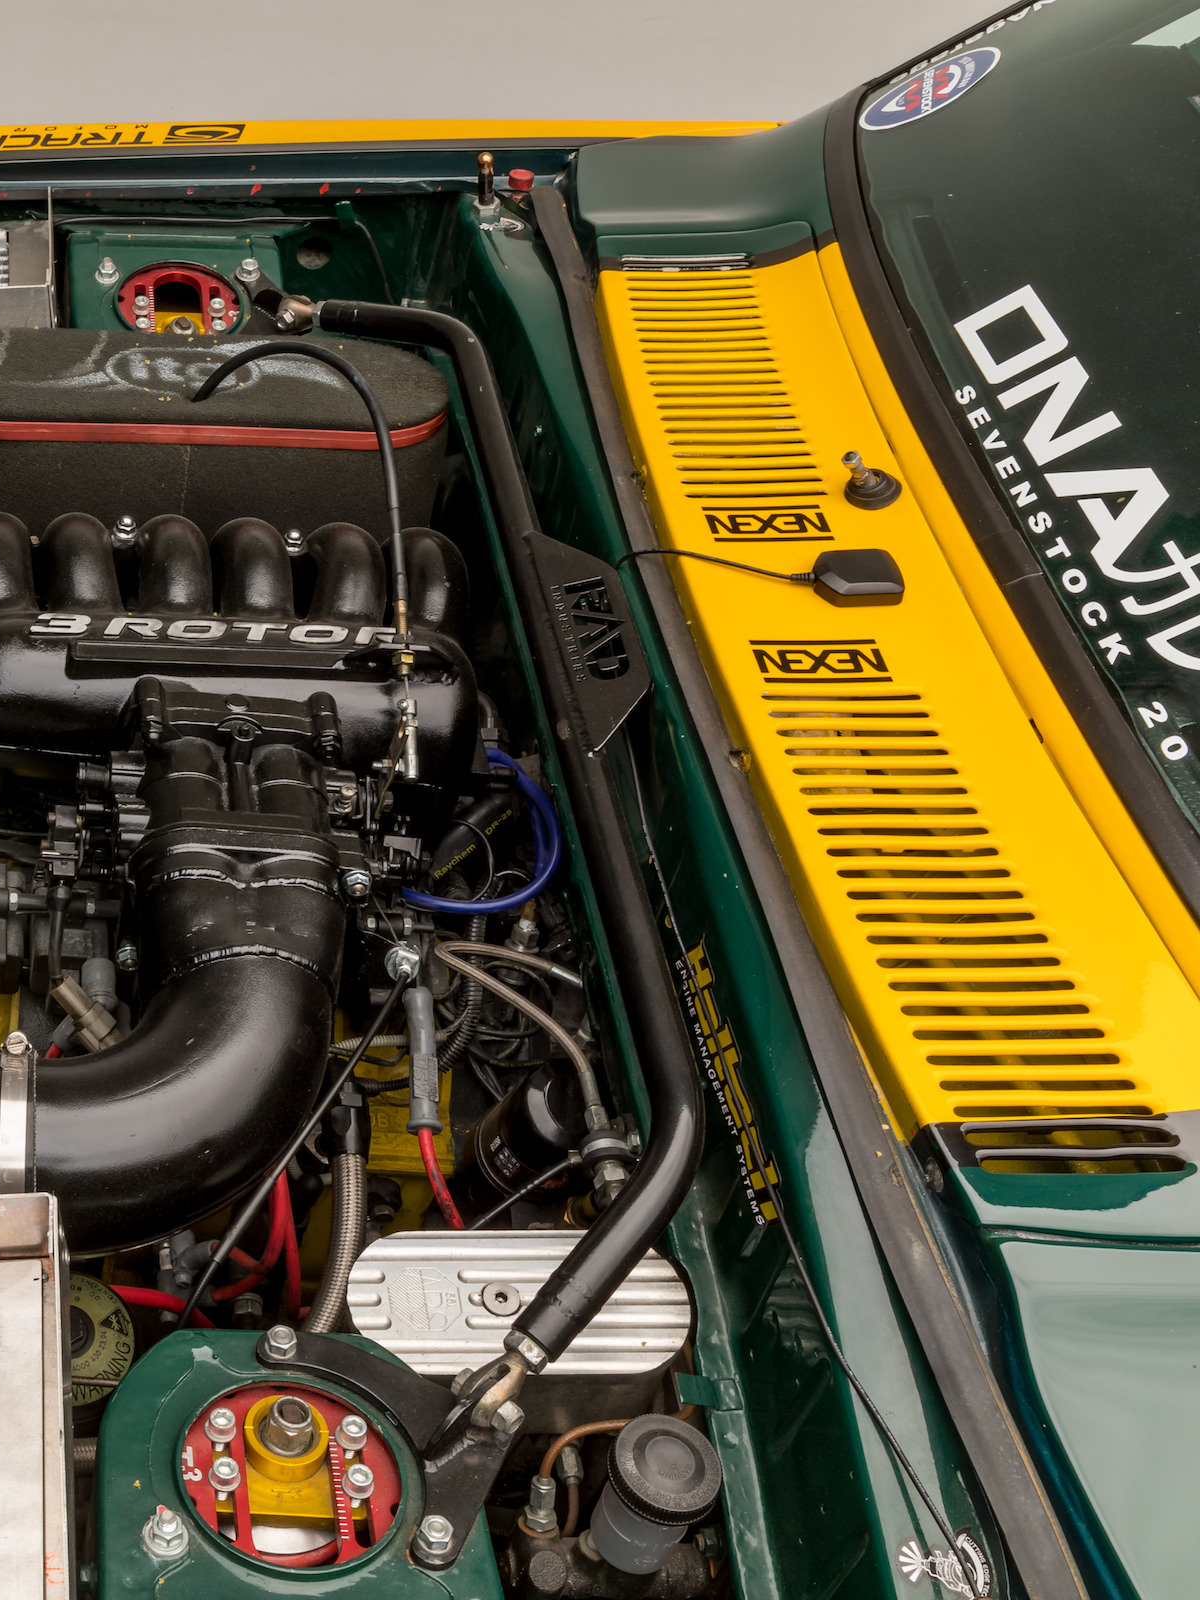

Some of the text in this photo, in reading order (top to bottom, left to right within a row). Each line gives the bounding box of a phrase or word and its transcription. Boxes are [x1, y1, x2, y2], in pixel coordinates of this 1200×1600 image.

[704, 512, 832, 534] NEXEN
[954, 385, 1189, 762] SEVENSTOCK 20
[29, 612, 93, 637] 3
[550, 585, 587, 682] INDUSTRIES
[563, 576, 630, 681] RAD
[752, 648, 889, 674] NEXEN
[433, 843, 477, 879] Raychem
[675, 958, 766, 1226] ENGINE MANAGEMENT SYSTEMS
